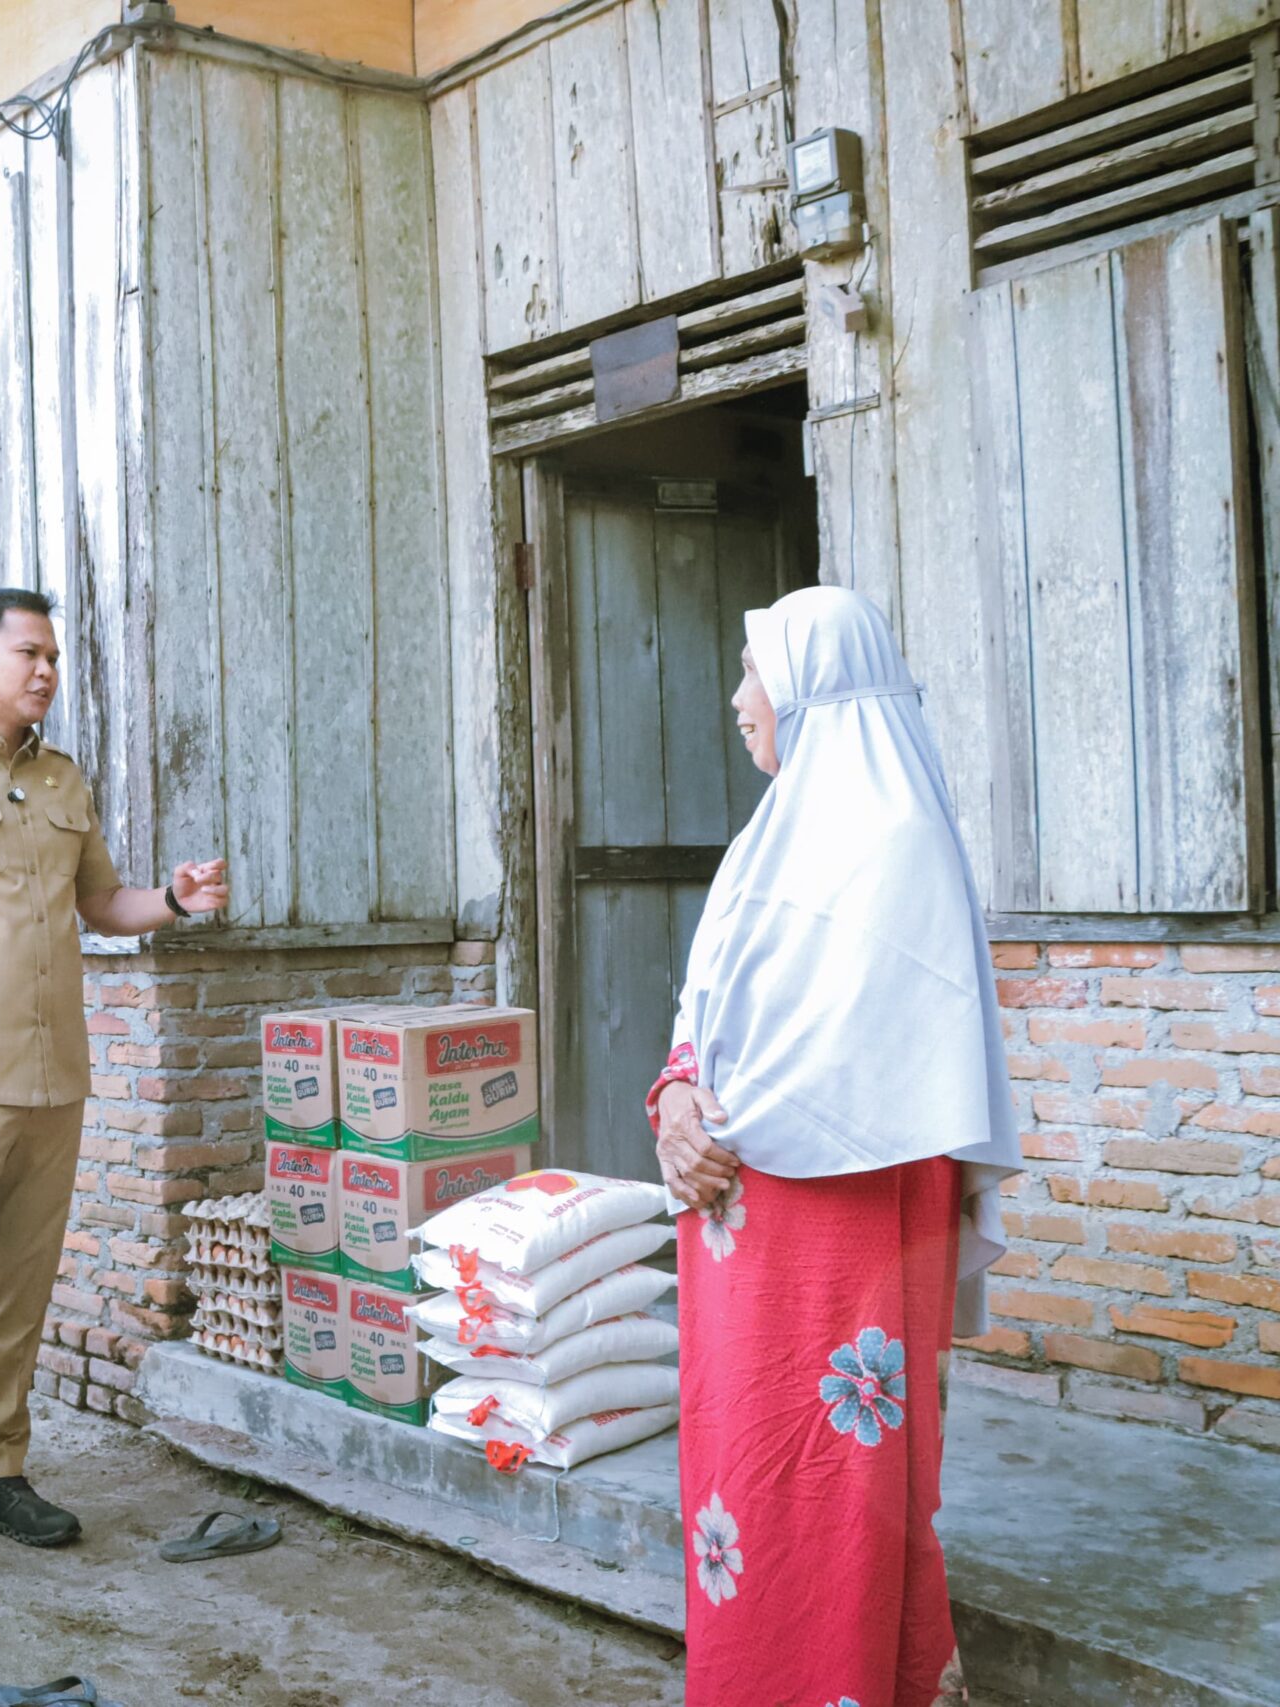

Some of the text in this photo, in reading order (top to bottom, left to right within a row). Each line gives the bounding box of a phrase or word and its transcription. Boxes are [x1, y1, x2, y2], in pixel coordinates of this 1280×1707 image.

[284, 1059, 299, 1072] 40
[363, 1068, 377, 1081] 40
[428, 1081, 462, 1093] Rasa
[429, 1091, 469, 1107] Kaldu
[429, 1107, 469, 1123] Ayam
[289, 1184, 305, 1198] 40
[362, 1200, 377, 1215] 40
[304, 1310, 318, 1324] 40
[369, 1332, 385, 1347] 40
